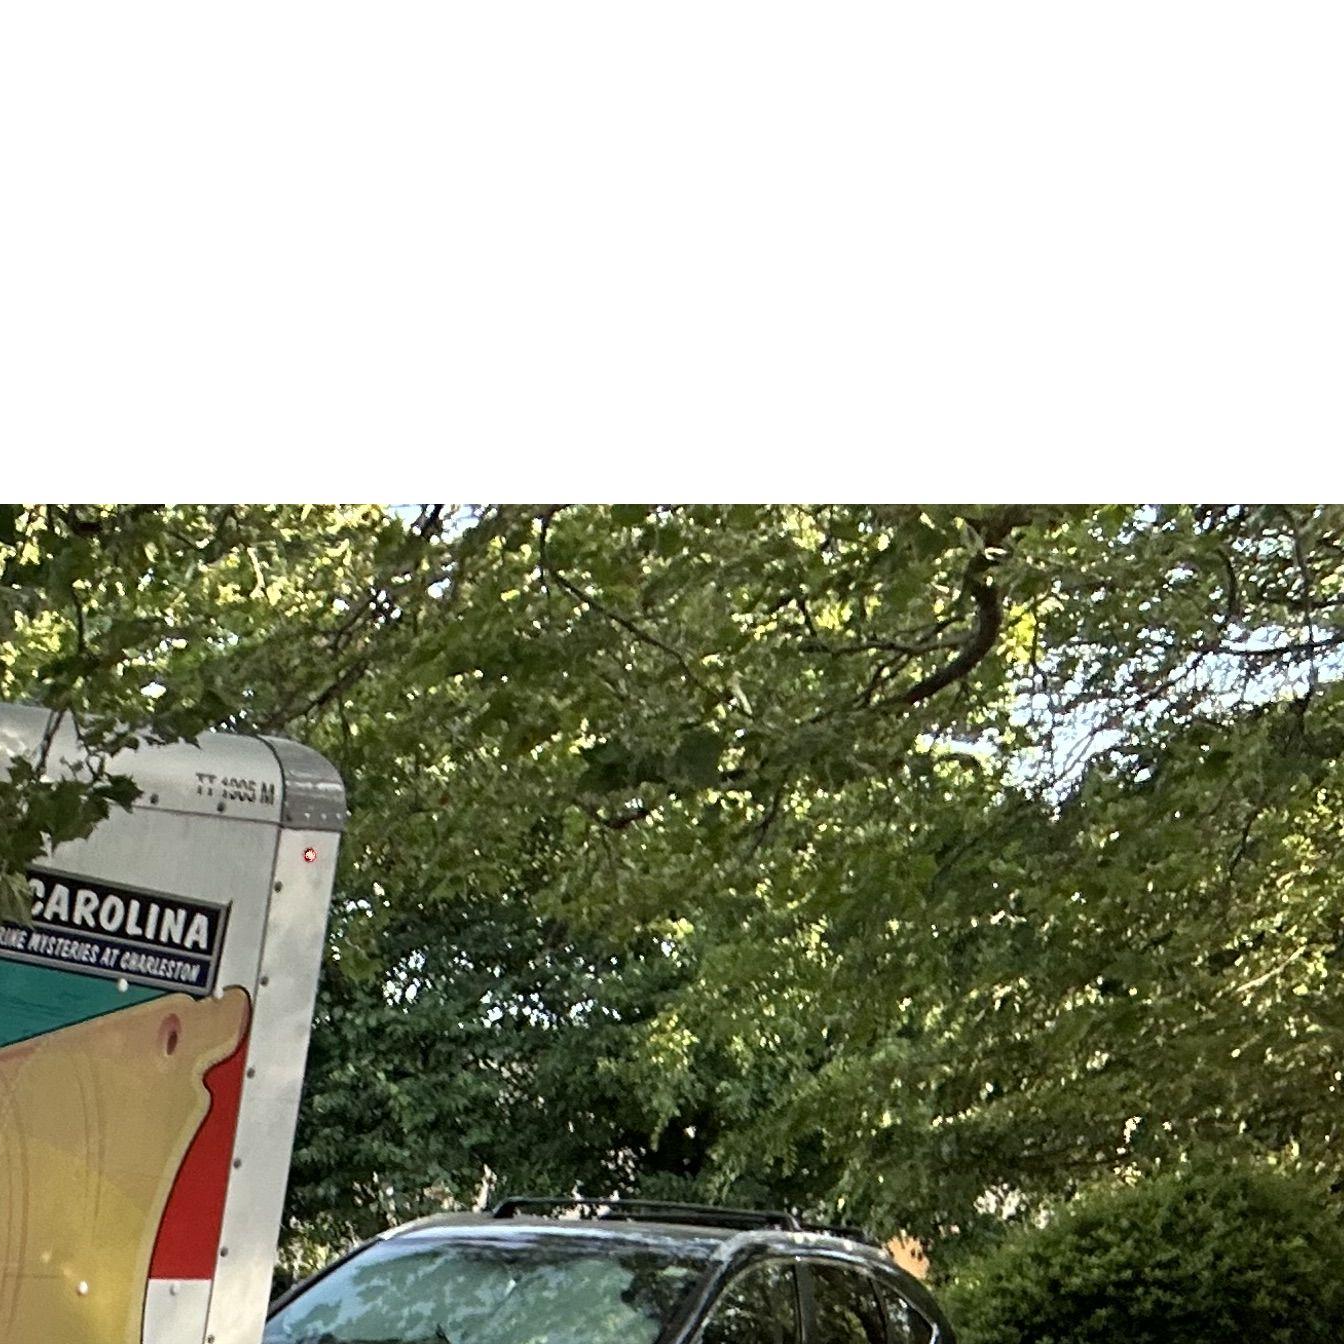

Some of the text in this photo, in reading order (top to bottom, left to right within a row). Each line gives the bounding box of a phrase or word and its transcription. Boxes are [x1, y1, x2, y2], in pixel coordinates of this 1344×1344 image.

[28, 878, 210, 949] CAROLINA
[27, 932, 100, 964] MYSTERIES
[99, 948, 120, 967] AT
[120, 951, 200, 983] CHARLESTON
